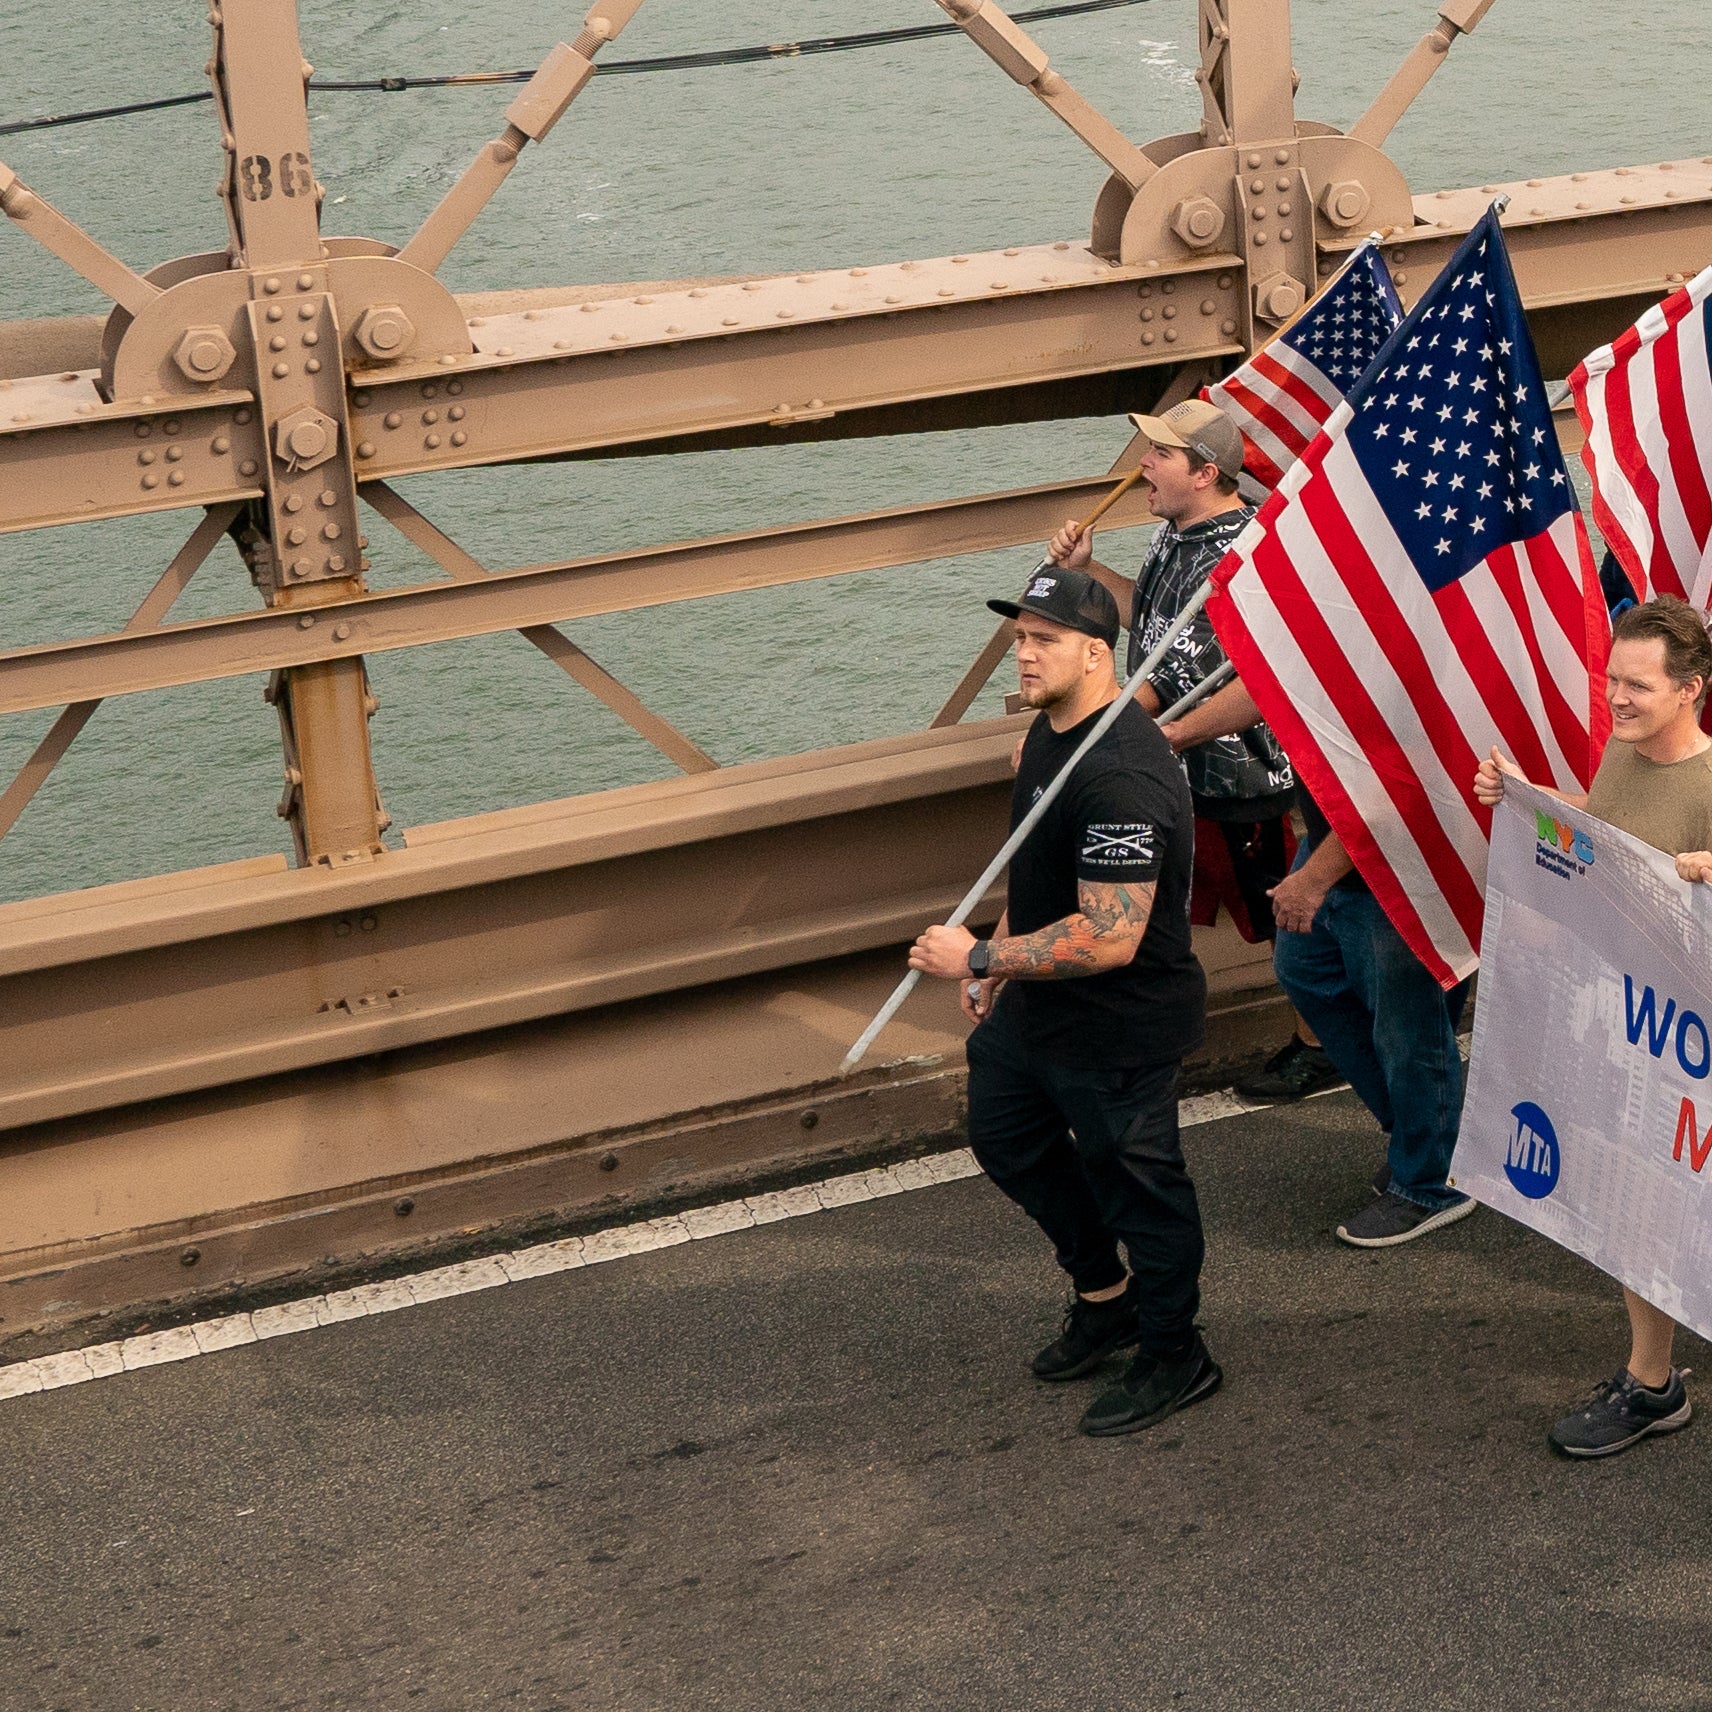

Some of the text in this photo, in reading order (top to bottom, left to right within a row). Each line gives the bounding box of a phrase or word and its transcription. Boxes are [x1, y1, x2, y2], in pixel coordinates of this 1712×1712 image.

[240, 152, 312, 202] 86
[1123, 823, 1153, 831] STYLE
[1534, 808, 1595, 865] NYC
[1104, 847, 1130, 857] GS
[1535, 854, 1571, 881] Education
[1536, 841, 1577, 873] Department
[1505, 1117, 1551, 1177] MTA
